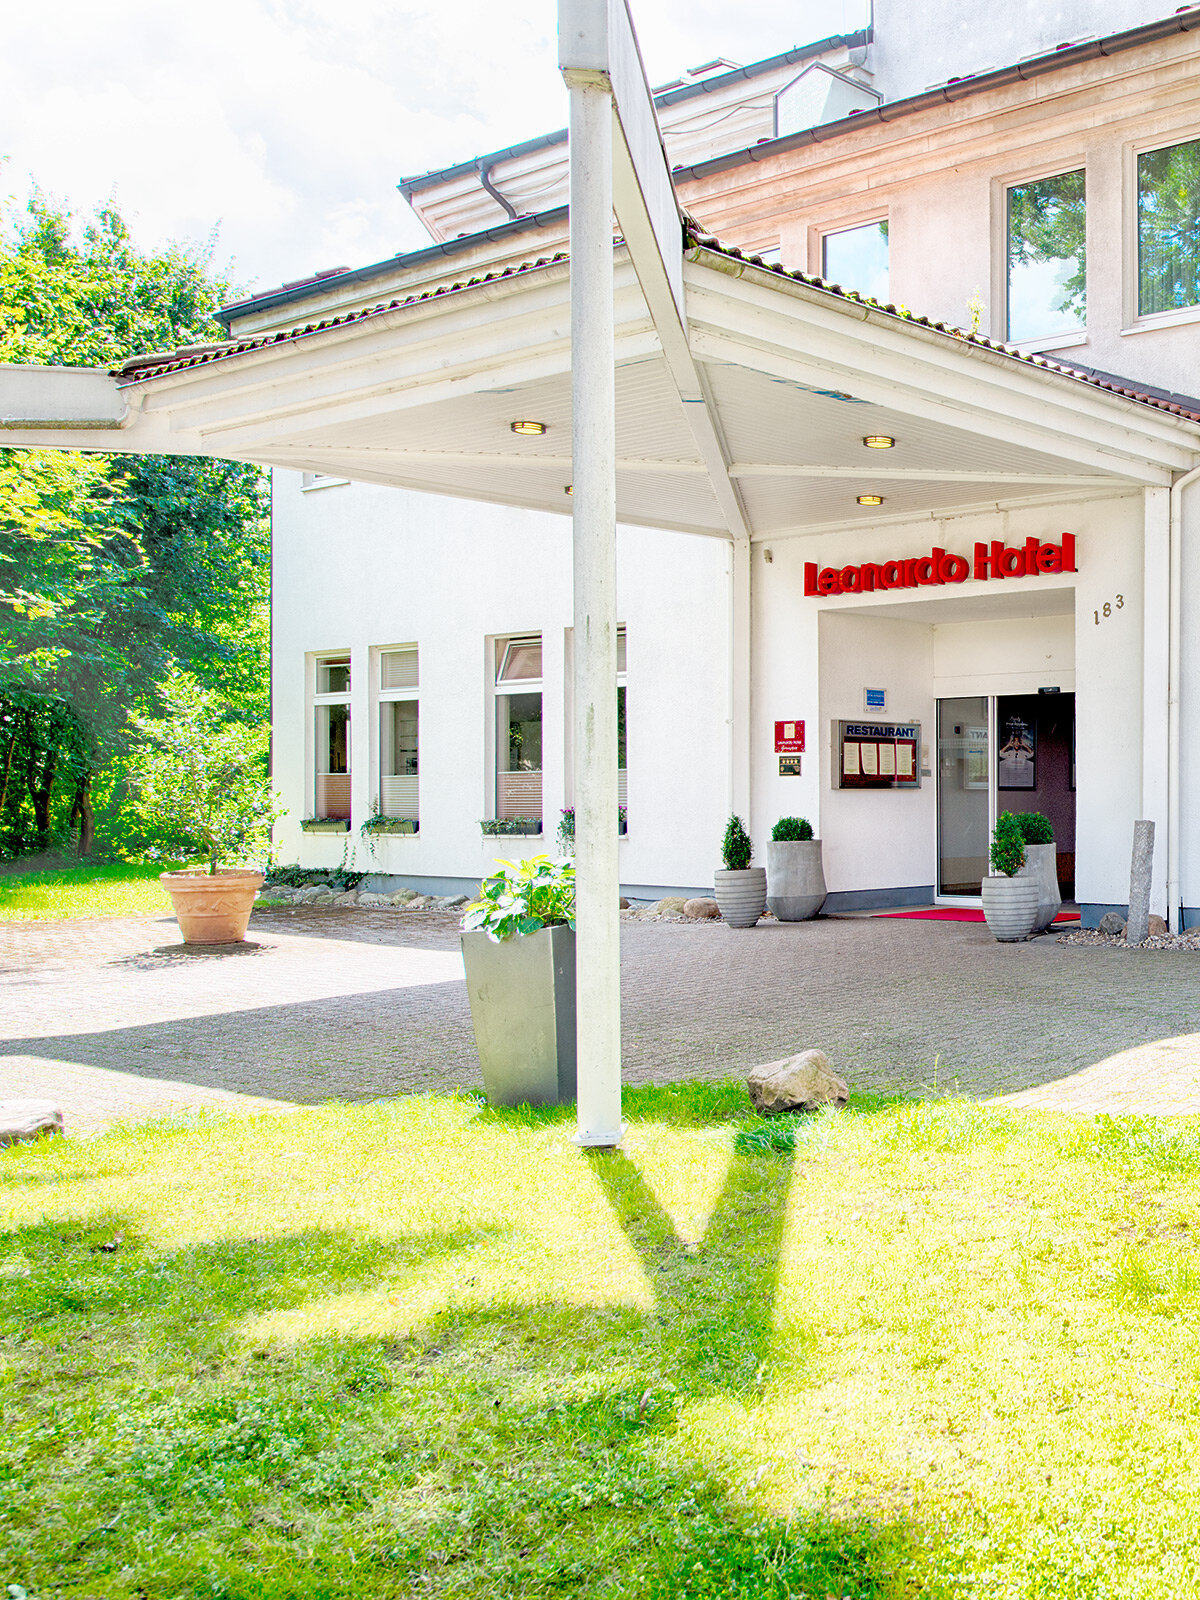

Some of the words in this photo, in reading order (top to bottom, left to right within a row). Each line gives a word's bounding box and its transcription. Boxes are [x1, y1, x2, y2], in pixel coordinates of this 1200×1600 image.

[804, 547, 970, 597] Leonardo
[974, 532, 1076, 581] Hotel
[1094, 594, 1124, 625] 183
[846, 725, 915, 737] RESTAURANT
